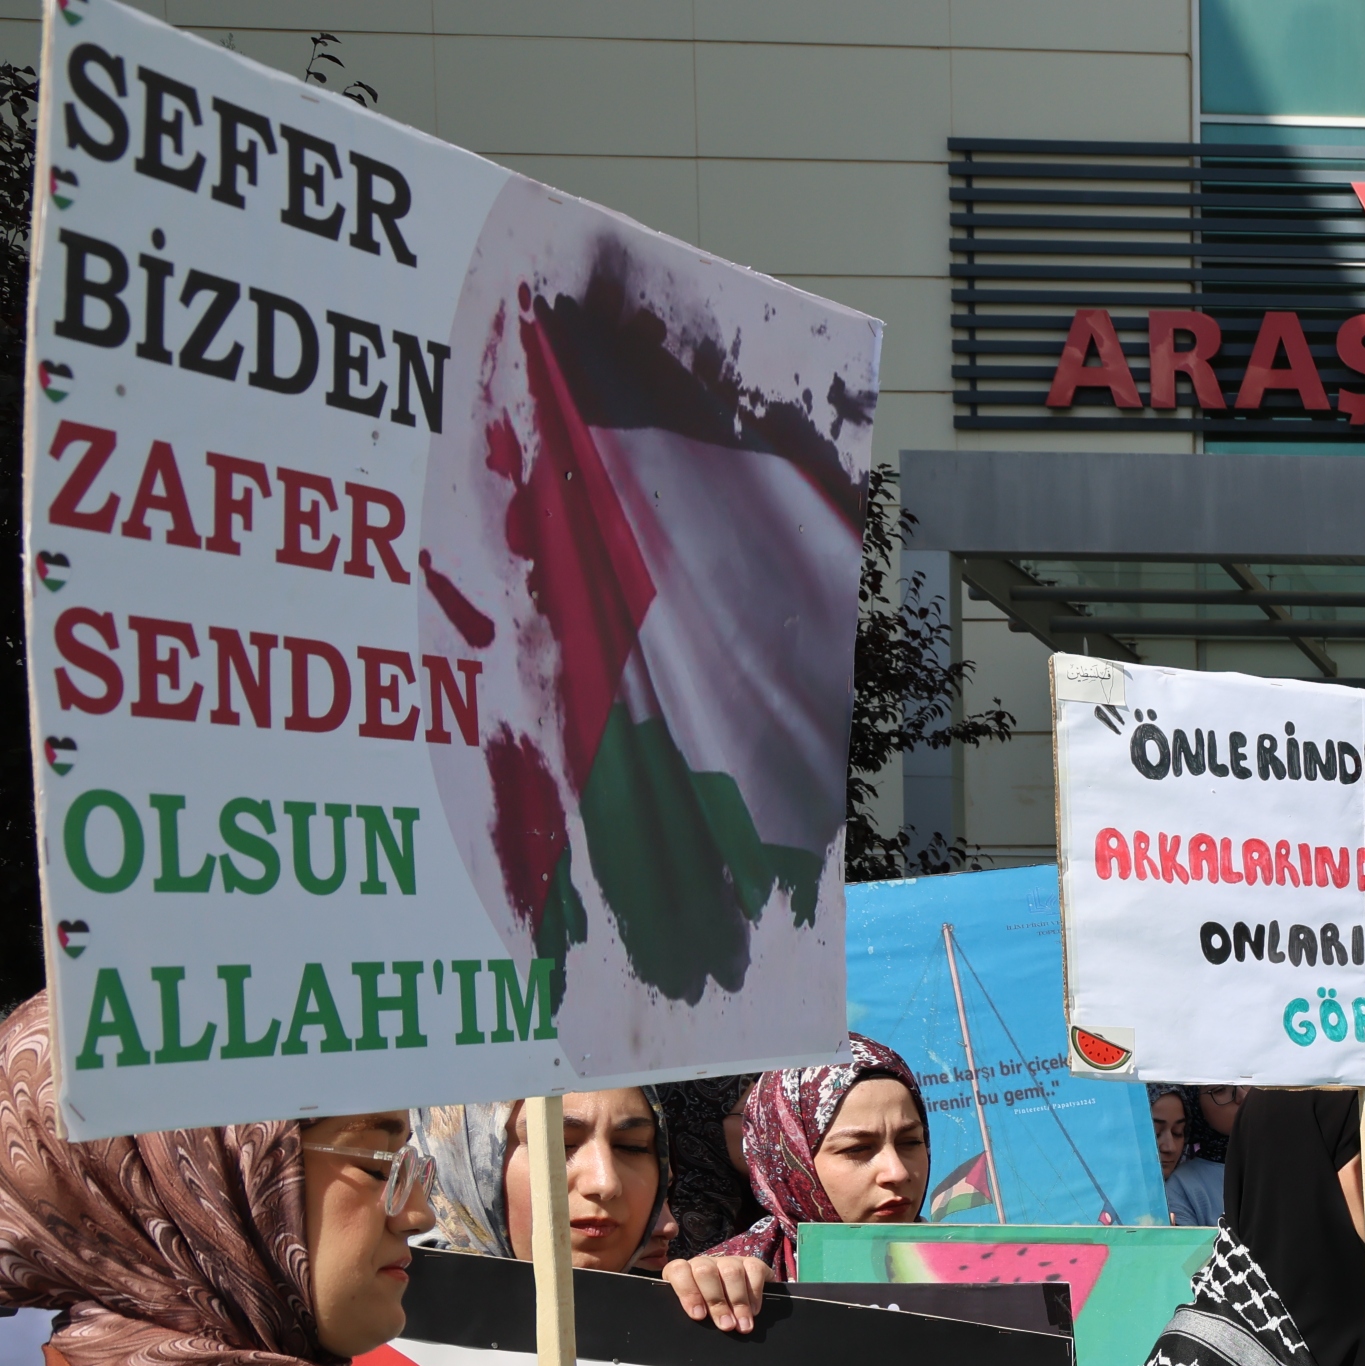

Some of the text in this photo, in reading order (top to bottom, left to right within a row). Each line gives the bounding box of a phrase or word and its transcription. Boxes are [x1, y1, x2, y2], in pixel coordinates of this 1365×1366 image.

[64, 42, 418, 268] SEFER
[54, 226, 451, 435] BİZDEN
[47, 420, 412, 586] ZAFER
[54, 606, 484, 747] SENDEN
[63, 789, 421, 896] OLSUN
[1201, 920, 1365, 966] ONLARI
[75, 958, 559, 1071] ALLAH'IM
[953, 1066, 996, 1083] karşı
[999, 1059, 1023, 1077] bir
[976, 1090, 999, 1106] bu
